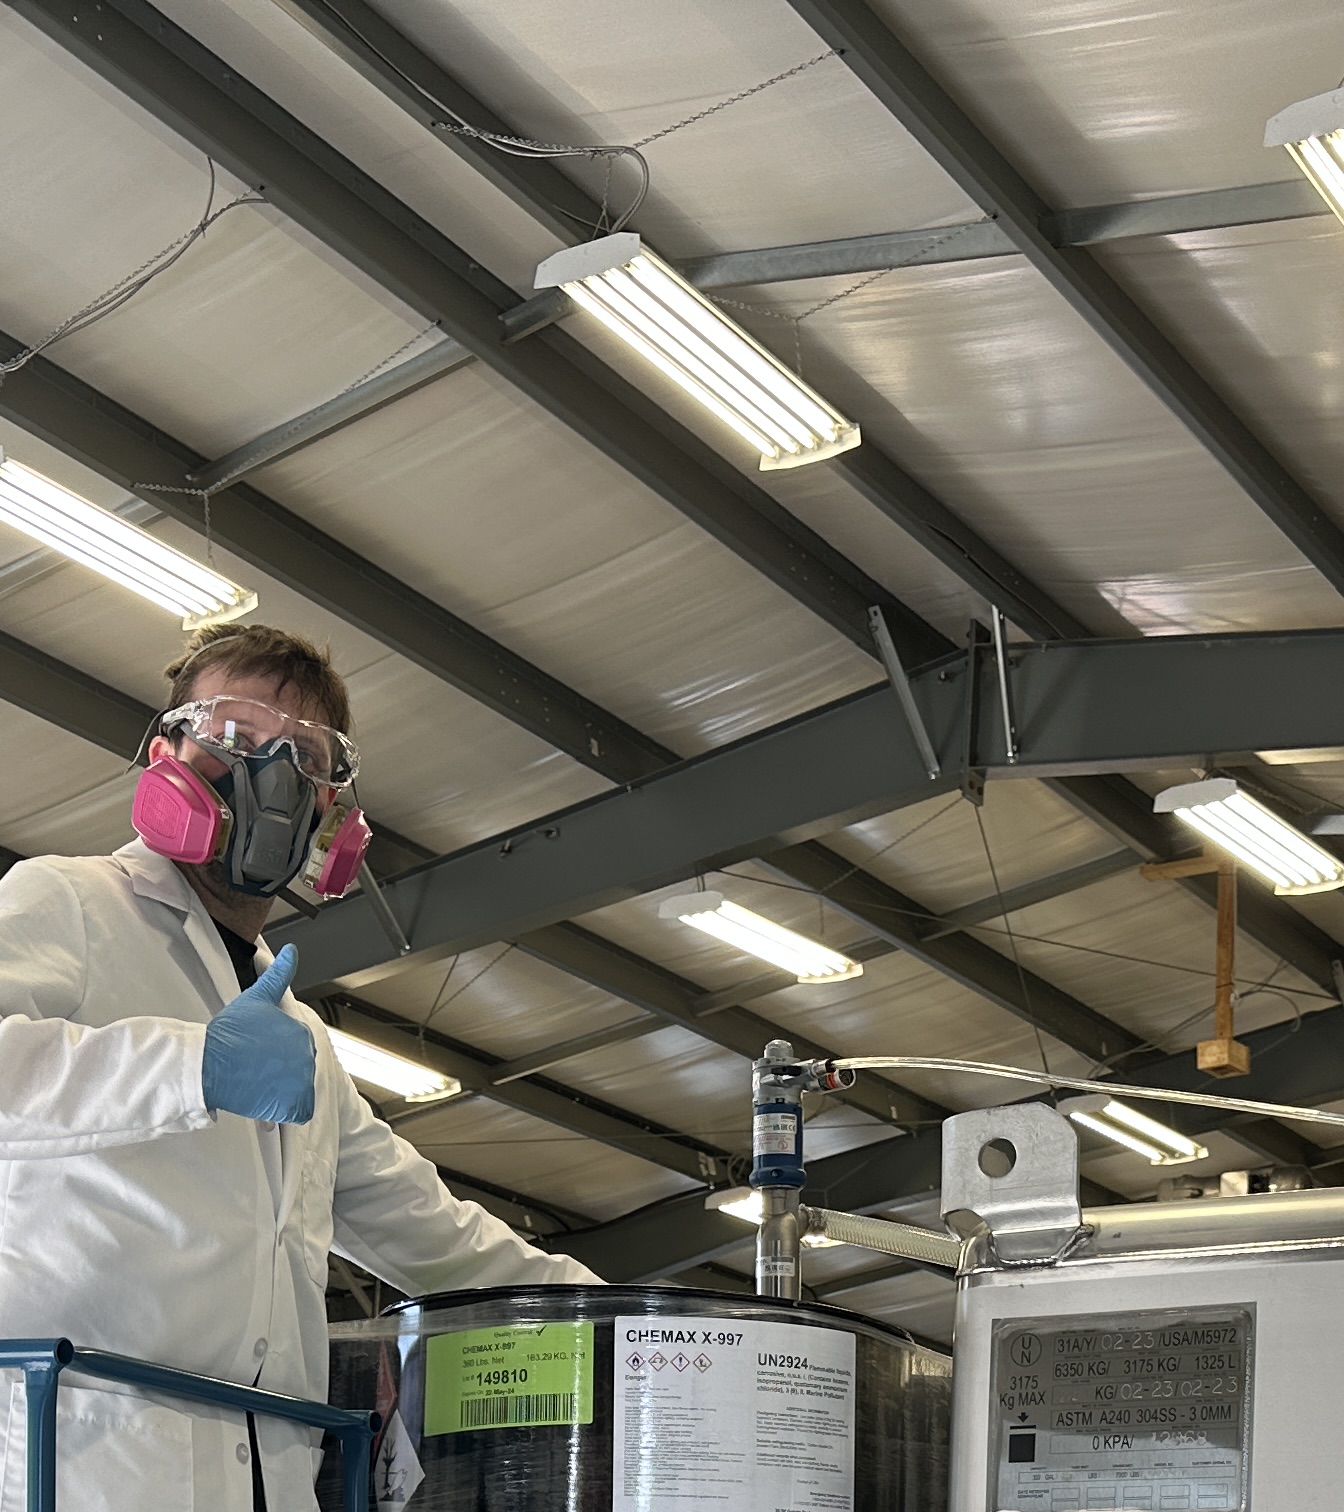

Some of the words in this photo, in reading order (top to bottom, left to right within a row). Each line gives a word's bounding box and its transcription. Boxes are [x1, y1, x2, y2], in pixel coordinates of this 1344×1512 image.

[626, 1329, 697, 1344] CHEMAX
[701, 1331, 743, 1346] X-997
[462, 1344, 492, 1355] CHEMAX
[758, 1353, 808, 1369] UN2924
[1054, 1362, 1084, 1378] 6350
[1123, 1358, 1153, 1374] 3175
[1195, 1354, 1225, 1370] 1325
[1228, 1353, 1235, 1368] L
[476, 1369, 528, 1386] 149810
[1010, 1375, 1038, 1391] 3175
[999, 1393, 1015, 1410] Kg
[1018, 1390, 1046, 1406] MAX
[1056, 1411, 1093, 1426] ASTM
[1099, 1409, 1130, 1425] A240
[1136, 1407, 1177, 1423] 304SS
[1104, 1434, 1134, 1450] KPA/
